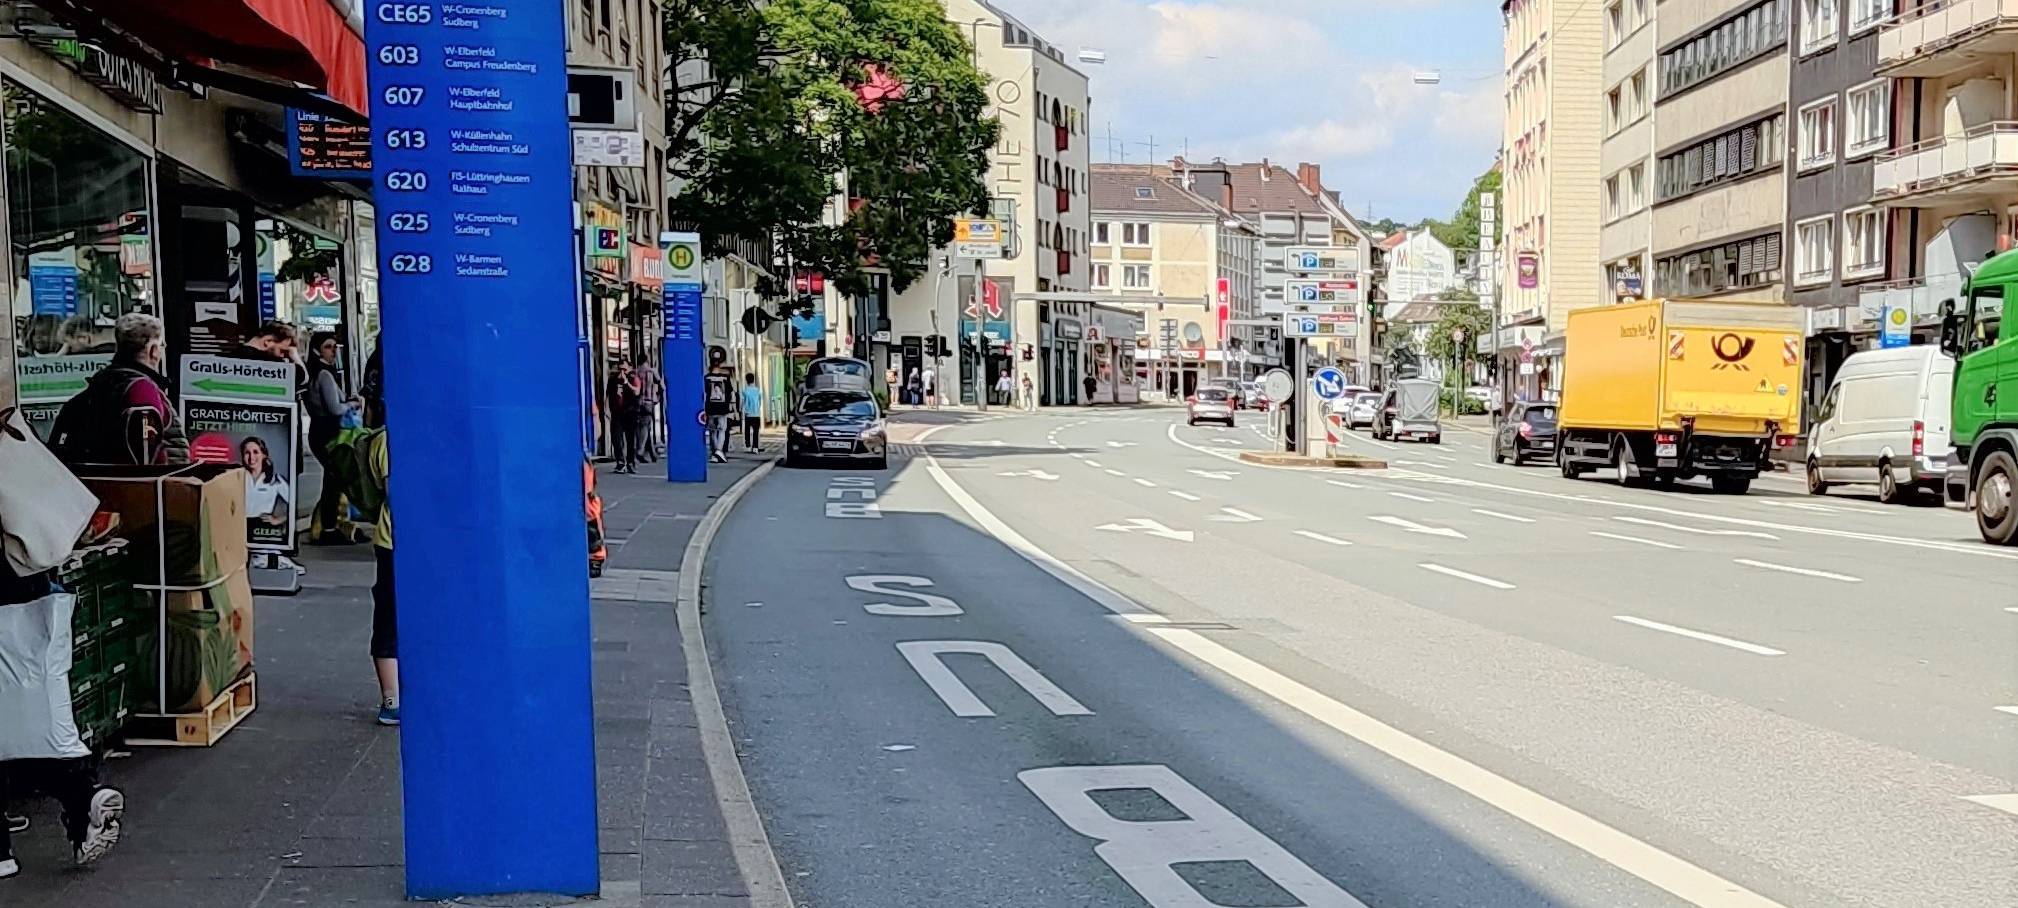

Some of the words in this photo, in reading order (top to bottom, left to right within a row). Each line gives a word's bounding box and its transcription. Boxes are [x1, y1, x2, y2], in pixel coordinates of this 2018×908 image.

[378, 3, 432, 24] CE65
[441, 4, 507, 18] W-Cronenberg
[379, 46, 419, 64] 603
[444, 46, 496, 57] W-Elberfeld
[445, 58, 481, 70] Campus
[482, 60, 537, 73] Freudenberg
[385, 87, 424, 105] 607
[449, 86, 500, 98] W-Elberfeld
[450, 100, 513, 111] Hauptbahnhof
[387, 130, 426, 148] 613
[450, 130, 513, 141] W-Küllenhahn
[451, 142, 510, 153] Schulzentrum
[511, 144, 529, 154] Süd
[387, 172, 427, 190] 620
[390, 213, 429, 231] 625
[453, 212, 518, 225] W-Cronenberg
[391, 254, 431, 272] 628
[455, 254, 502, 263] W-Barmen
[190, 408, 231, 420] GRATIS
[232, 409, 287, 423] HÖRTEST
